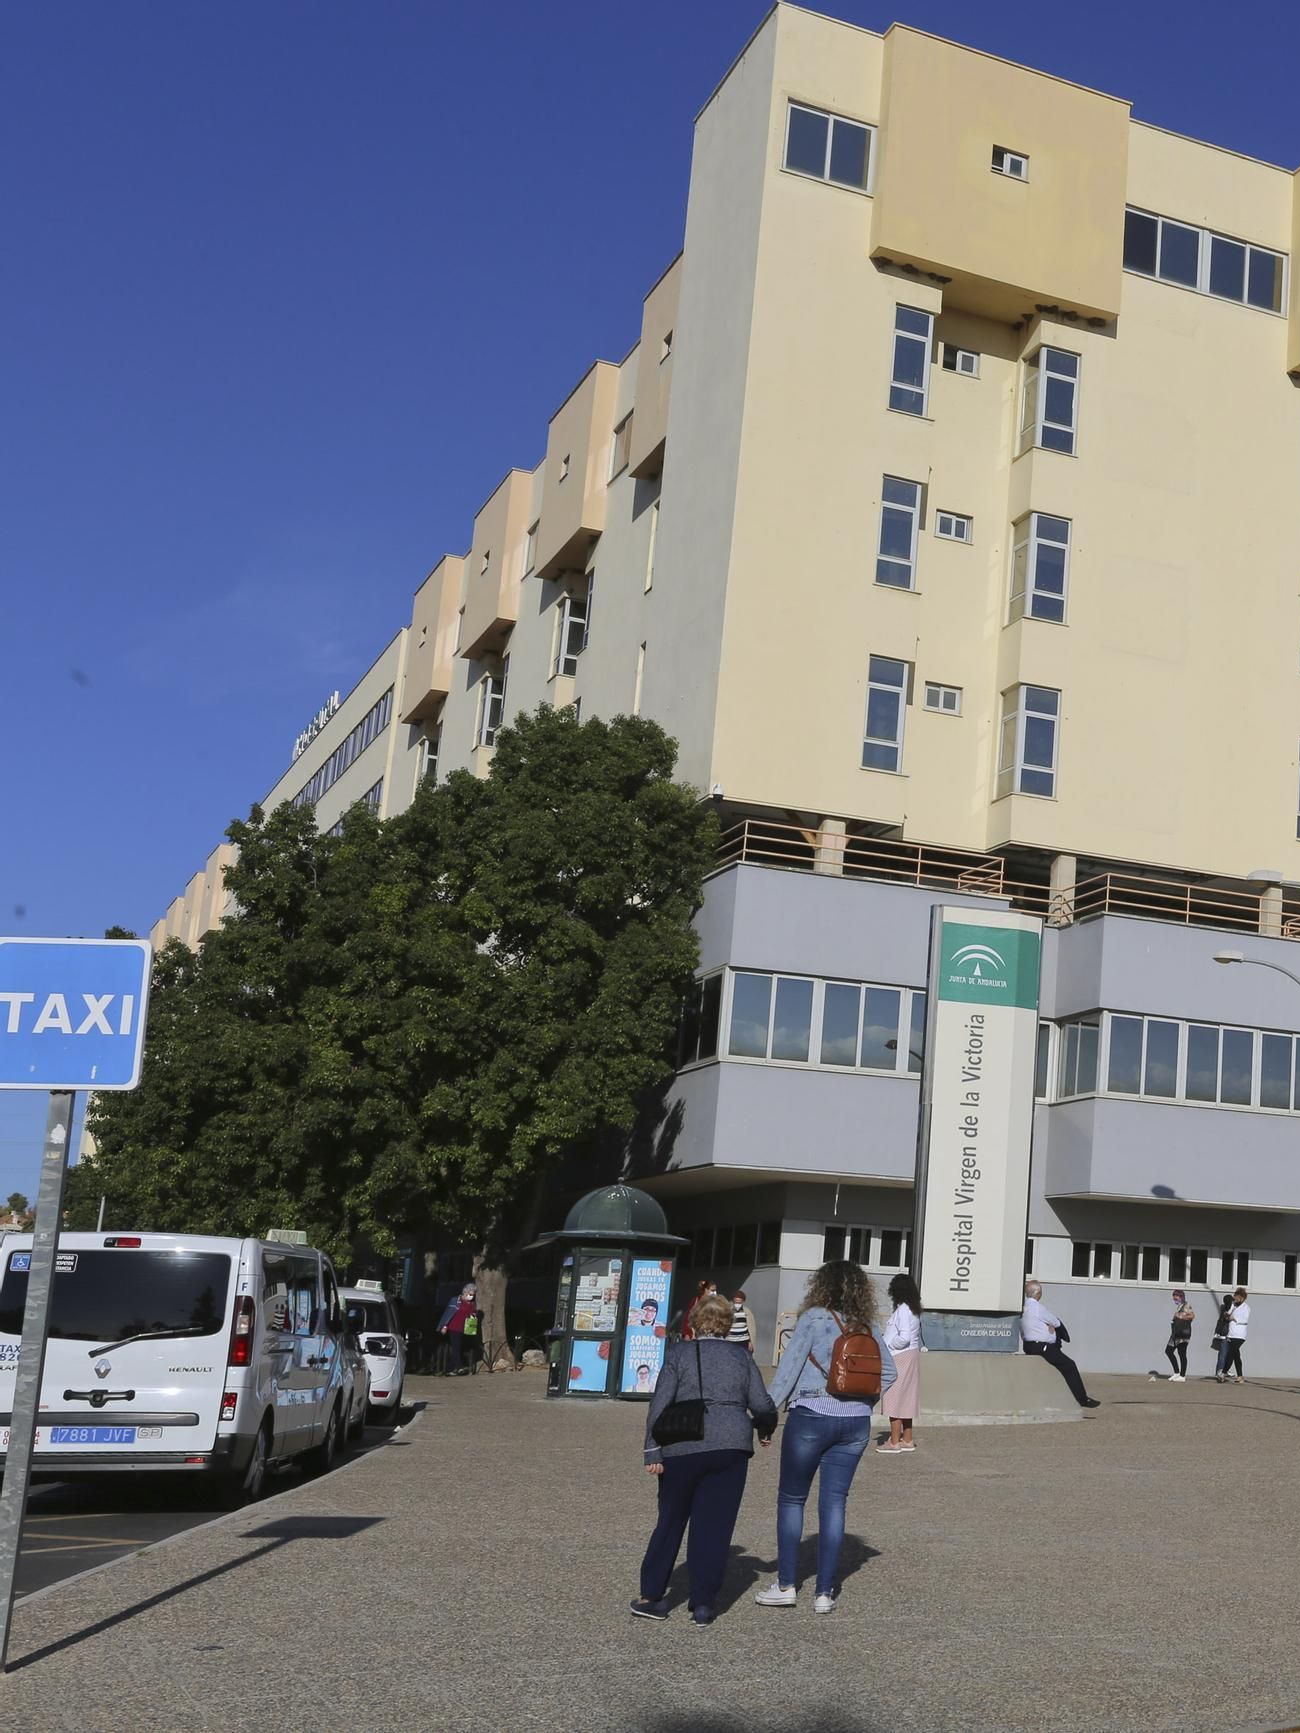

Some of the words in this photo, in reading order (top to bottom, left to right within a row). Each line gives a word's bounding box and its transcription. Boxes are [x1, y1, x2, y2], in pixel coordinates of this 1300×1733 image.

[949, 975, 967, 984] JUNTA
[968, 977, 976, 985] DE
[0, 992, 134, 1035] TAXI
[961, 1014, 985, 1083] Victoria
[960, 1091, 980, 1107] la
[958, 1115, 979, 1138] de
[954, 1146, 981, 1205] Virgen
[949, 1214, 977, 1292] Hospital
[636, 1282, 666, 1291] JUGAMOS
[635, 1291, 665, 1302] TODOS
[630, 1335, 661, 1346] SOMOS
[0, 1344, 21, 1353] TAX
[629, 1351, 660, 1359] JUGAMOS
[628, 1359, 659, 1371] TODOS
[58, 1428, 99, 1442] 7881
[103, 1429, 133, 1442] JVF
